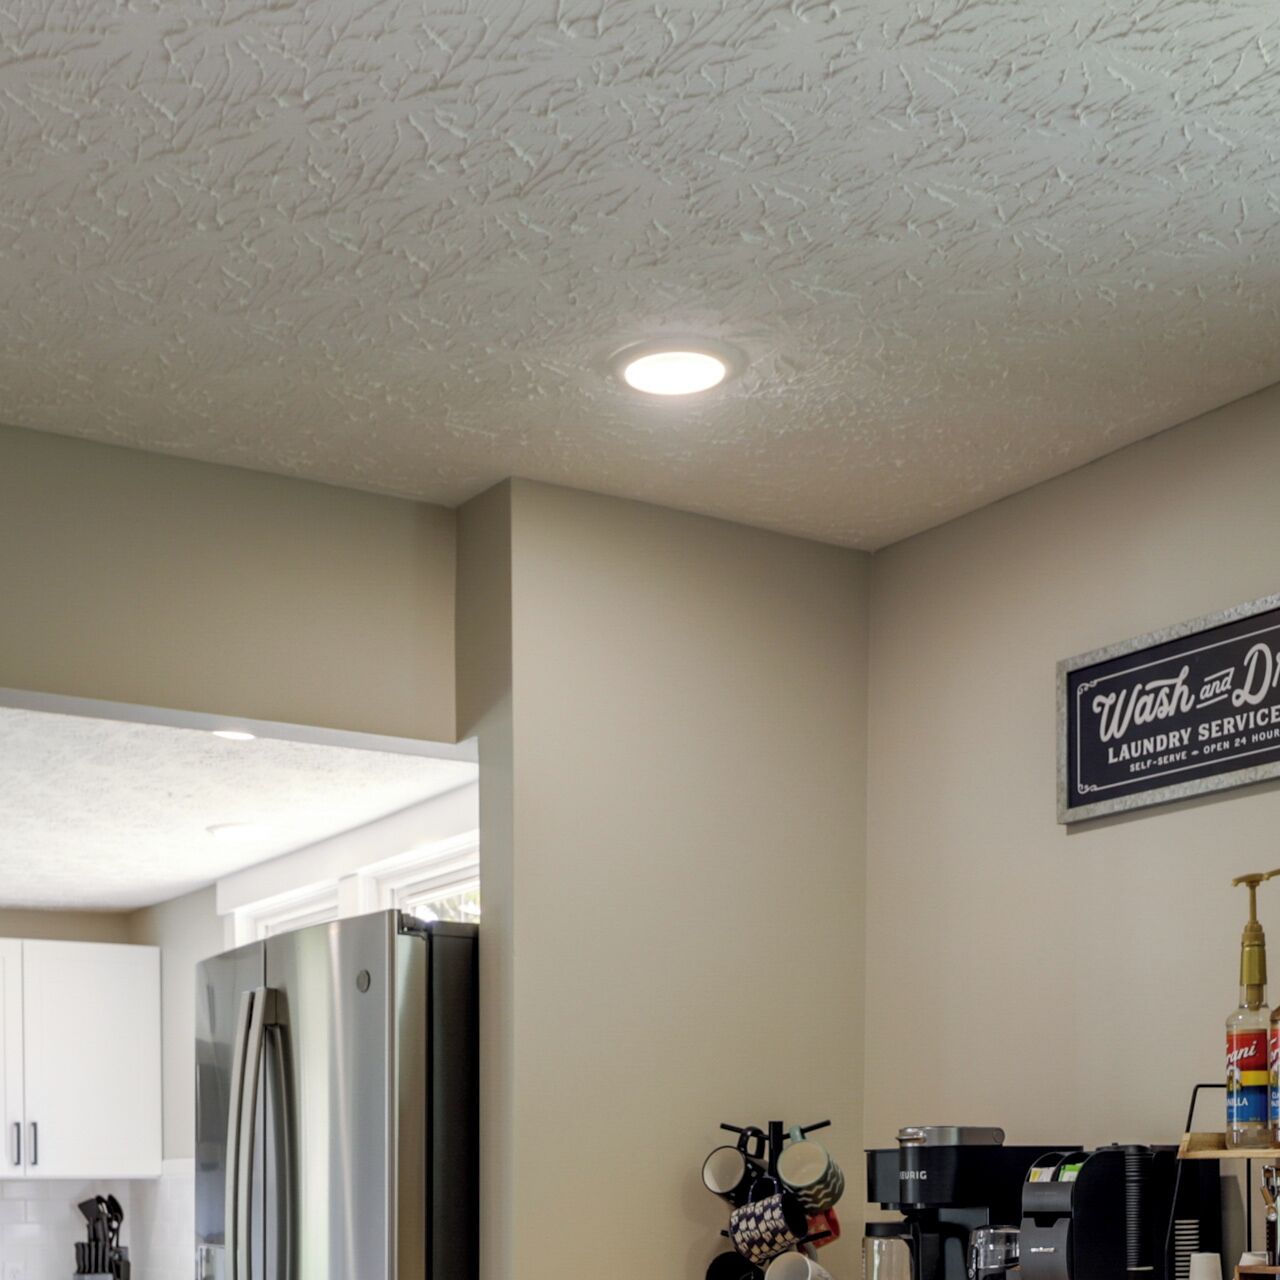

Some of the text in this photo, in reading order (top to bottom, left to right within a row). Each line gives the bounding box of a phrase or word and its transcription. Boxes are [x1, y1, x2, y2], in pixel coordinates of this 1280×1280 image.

[1092, 665, 1195, 742] Wash
[1200, 666, 1235, 700] and
[1108, 727, 1192, 765] LAUNDRY
[1129, 750, 1188, 773] SELF-SERVE
[1203, 740, 1230, 755] OPEN
[1234, 736, 1247, 748] 24
[1226, 1040, 1258, 1064] rani
[899, 1169, 928, 1180] EURIG
